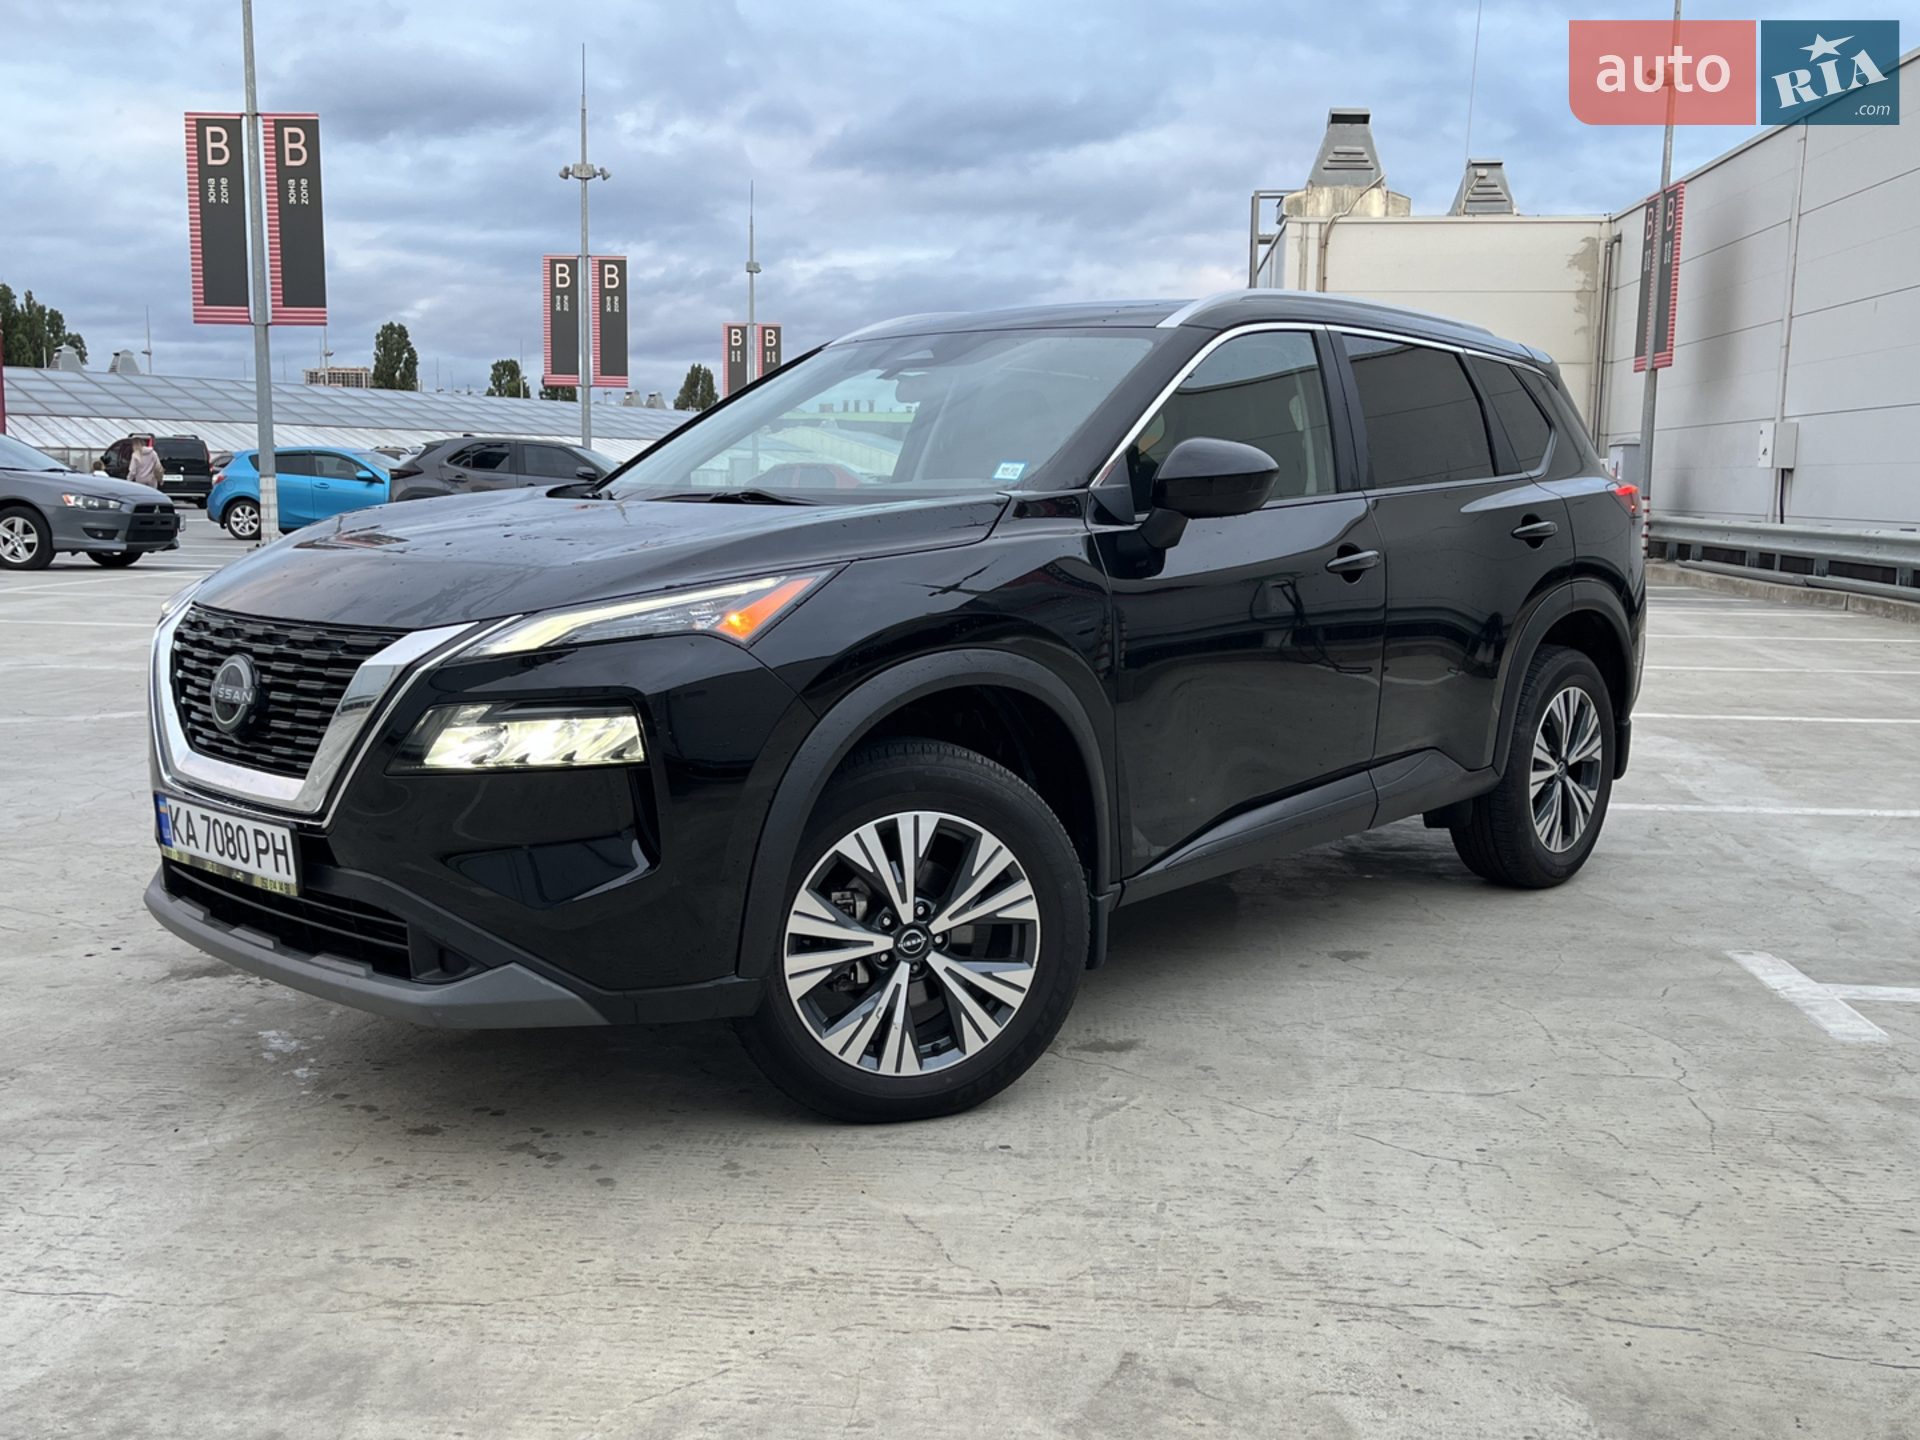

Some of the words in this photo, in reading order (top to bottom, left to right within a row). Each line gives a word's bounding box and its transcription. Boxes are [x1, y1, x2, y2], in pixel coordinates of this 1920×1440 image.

[205, 126, 230, 165] B
[283, 127, 308, 166] B
[207, 178, 216, 204] зона
[220, 177, 229, 204] zone
[288, 179, 297, 205] зона
[300, 178, 309, 205] zone
[1646, 207, 1654, 240] B
[1666, 197, 1675, 232] B
[555, 263, 571, 288] B
[604, 264, 620, 289] B
[731, 328, 742, 346] B
[765, 329, 777, 347] B
[168, 804, 200, 850] KA
[200, 814, 250, 865] 7080
[253, 828, 291, 876] PH
